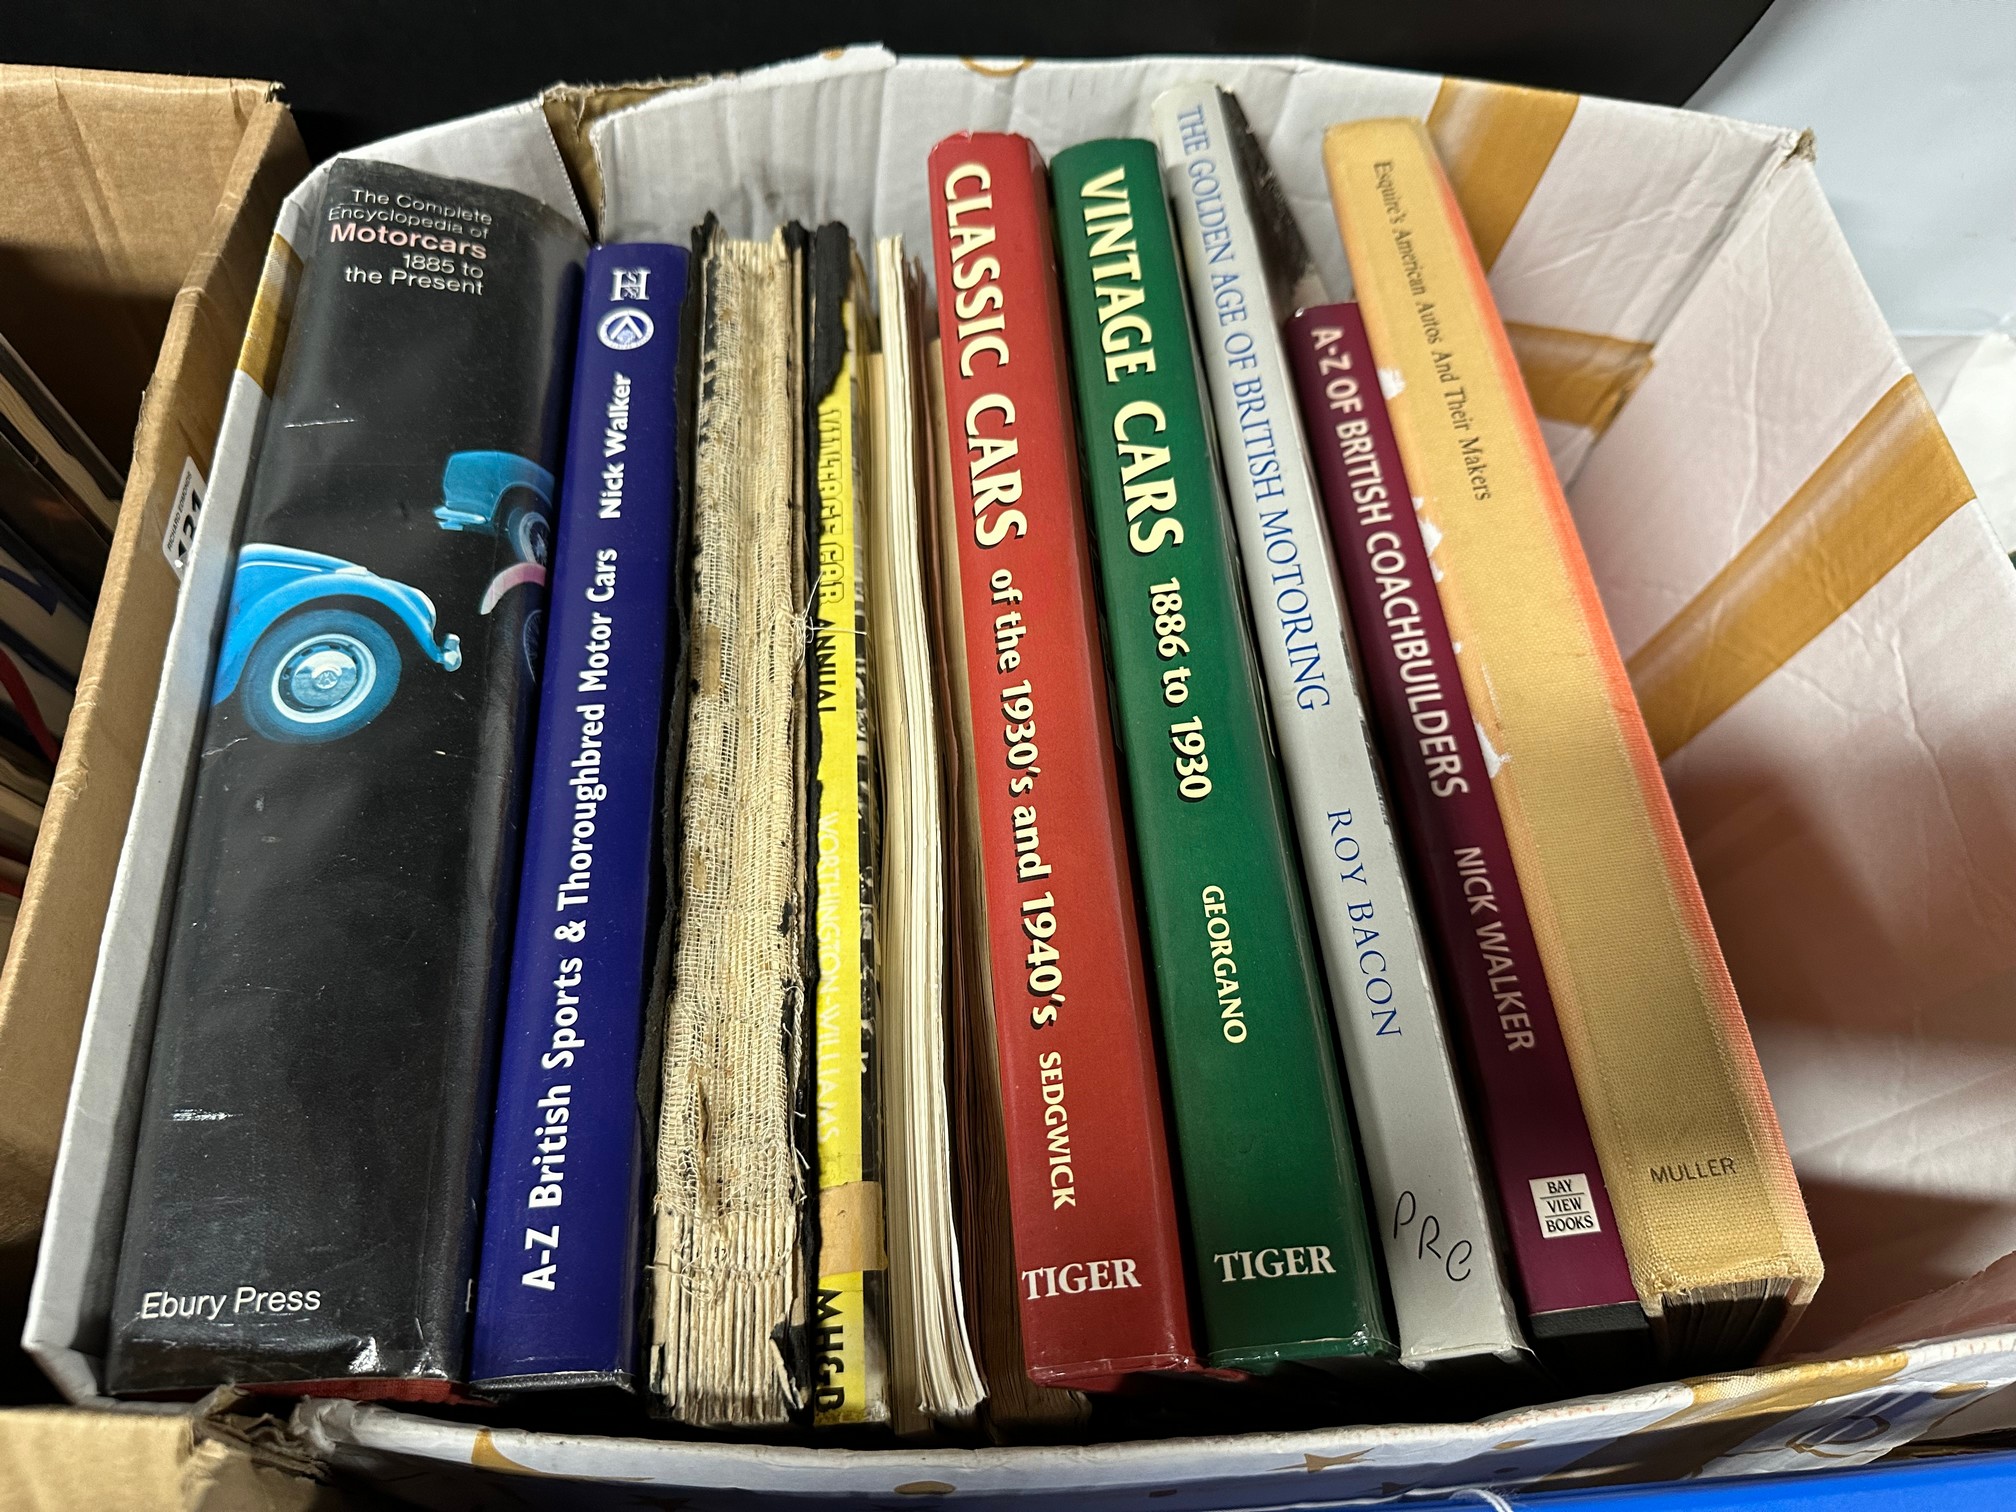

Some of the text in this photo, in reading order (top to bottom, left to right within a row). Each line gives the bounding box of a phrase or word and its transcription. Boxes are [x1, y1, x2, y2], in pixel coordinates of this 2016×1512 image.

[328, 206, 489, 240] Encyclopedia of
[352, 188, 492, 225] The Complete
[330, 223, 487, 260] Motorcars
[403, 254, 484, 279] 1885 to
[345, 265, 484, 296] the Present
[1373, 160, 1492, 501] Esquire's American Autos And Their Makers
[603, 371, 632, 458] Walker
[1178, 104, 1331, 712] THE GOLDEN AGE OF BRITISH MOTORING
[1326, 377, 1363, 414] OF
[598, 461, 625, 519] Nick
[1079, 165, 1213, 803] VINTAGE CARS 1886 to 1930
[1335, 417, 1391, 527] BRITISH
[167, 511, 182, 552] RICHARD
[944, 161, 1065, 1026] CLASSIC CARS of the 1930's and 1940's
[1366, 522, 1471, 798] COACHBUILDERS
[521, 548, 617, 1292] A-Z British Sports & Thoroughbred Motor Cars
[1327, 807, 1403, 1040] ROY BACON
[1201, 884, 1247, 1046] GEORGANO
[1454, 846, 1535, 1054] NICK WALKER
[817, 811, 841, 1143] WORTHINGTON-WILLIAMS
[1037, 1050, 1077, 1210] SEDGWICK
[1547, 1179, 1573, 1194] BAY
[1650, 1156, 1737, 1184] MULLER
[1545, 1215, 1594, 1233] BOOKS
[1547, 1197, 1582, 1213] VIEW
[1021, 1257, 1143, 1302] TIGER
[1213, 1244, 1336, 1286] TIGER
[140, 1284, 322, 1321] Ebury Press
